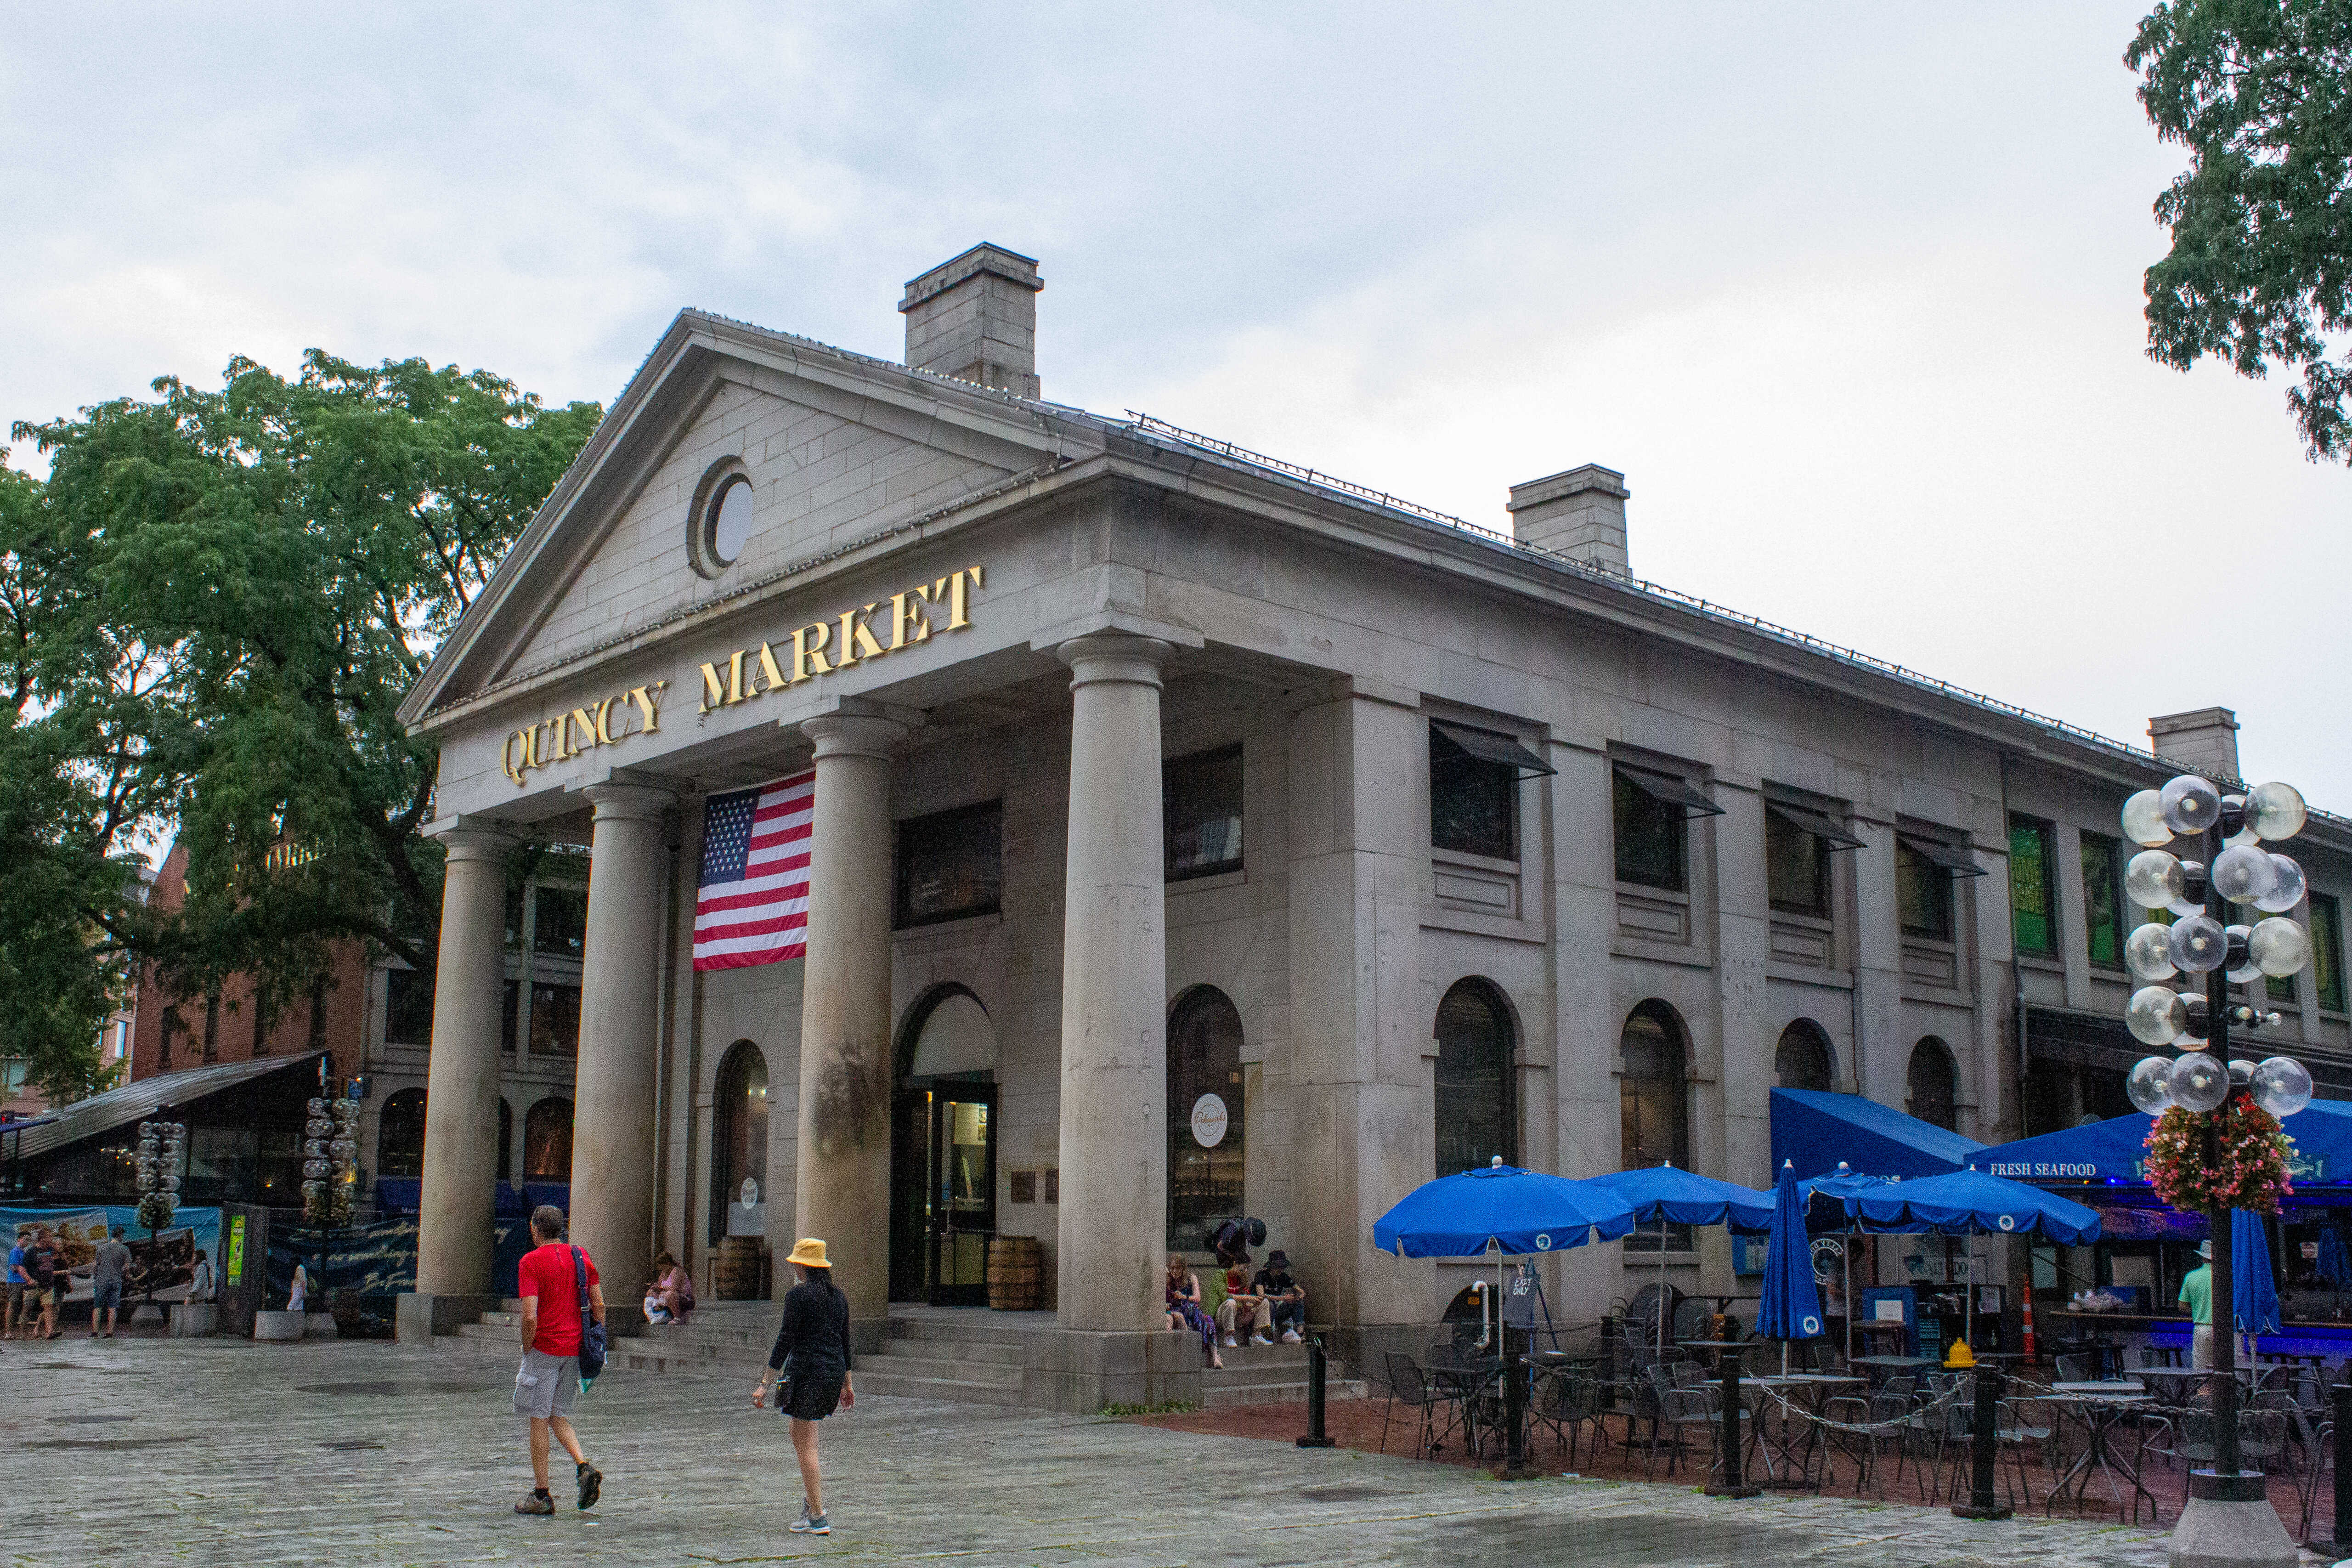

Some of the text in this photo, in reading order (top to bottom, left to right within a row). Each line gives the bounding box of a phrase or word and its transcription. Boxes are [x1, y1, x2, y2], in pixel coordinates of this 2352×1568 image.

[501, 566, 981, 786] QUINCY MARKET
[1990, 1163, 2096, 1176] FRESH SEAFOOD
[1514, 1277, 1532, 1286] EXIT
[1513, 1287, 1529, 1296] ONLY
